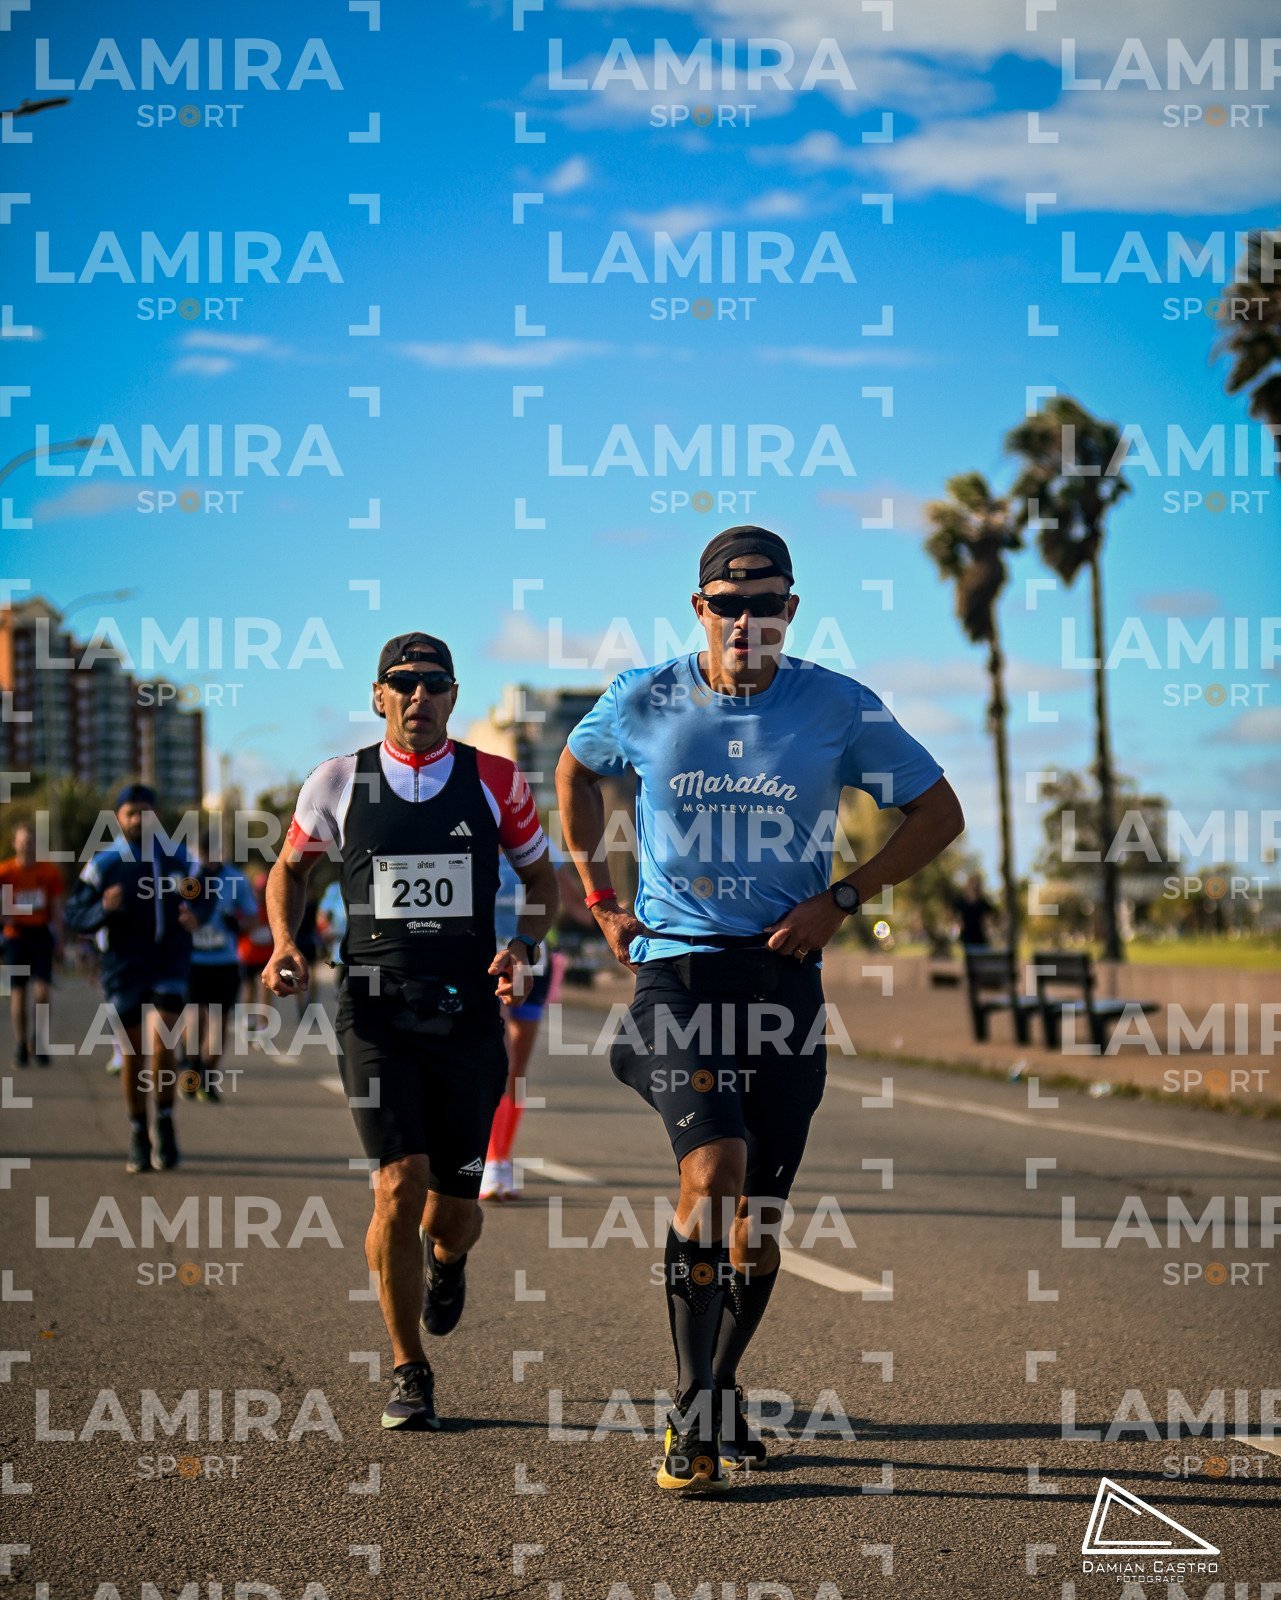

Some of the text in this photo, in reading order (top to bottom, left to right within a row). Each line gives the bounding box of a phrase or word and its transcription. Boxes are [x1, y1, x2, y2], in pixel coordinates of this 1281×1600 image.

[669, 769, 798, 802] Maratón
[682, 803, 786, 815] MONTEVIDEO
[391, 877, 454, 908] 230
